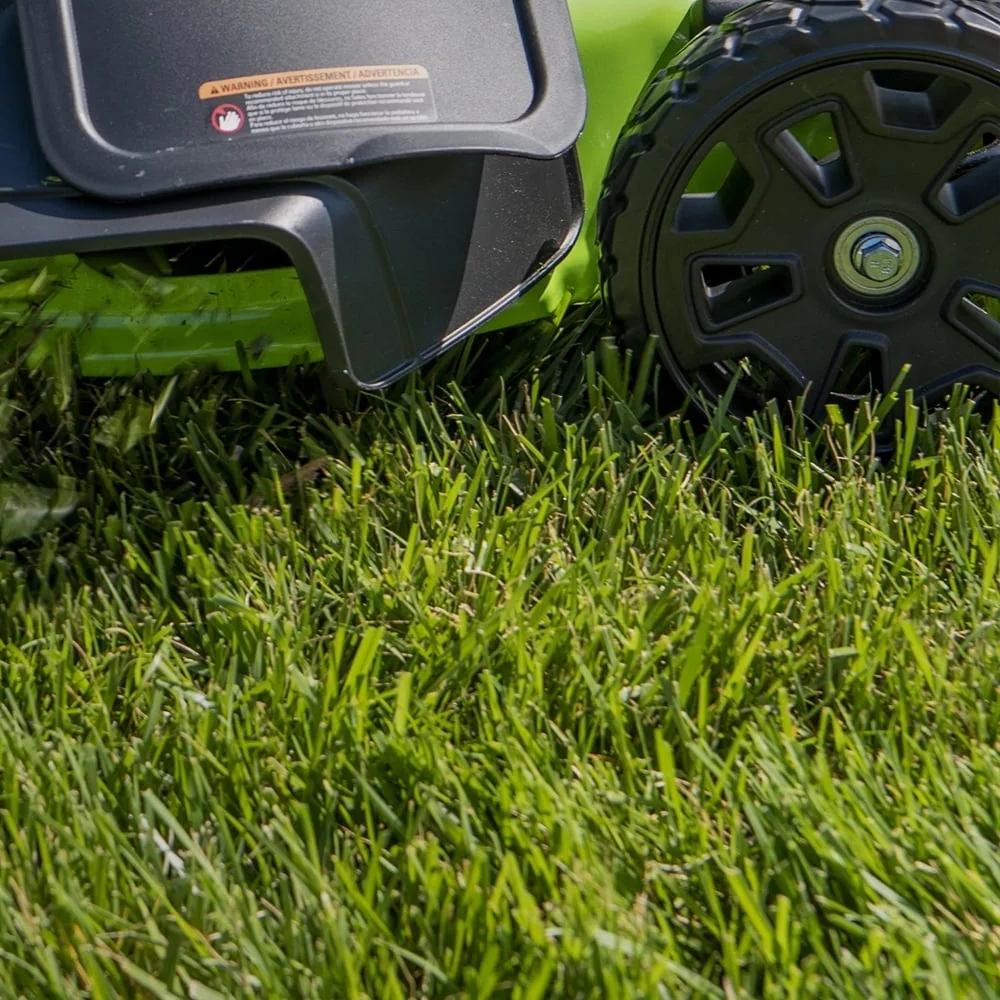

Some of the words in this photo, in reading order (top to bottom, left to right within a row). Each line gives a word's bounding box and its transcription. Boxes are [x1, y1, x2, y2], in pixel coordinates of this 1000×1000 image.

[220, 78, 269, 93] WARNING
[275, 70, 351, 86] AVERTISSEMENT
[358, 67, 420, 79] ADVERTENCIA
